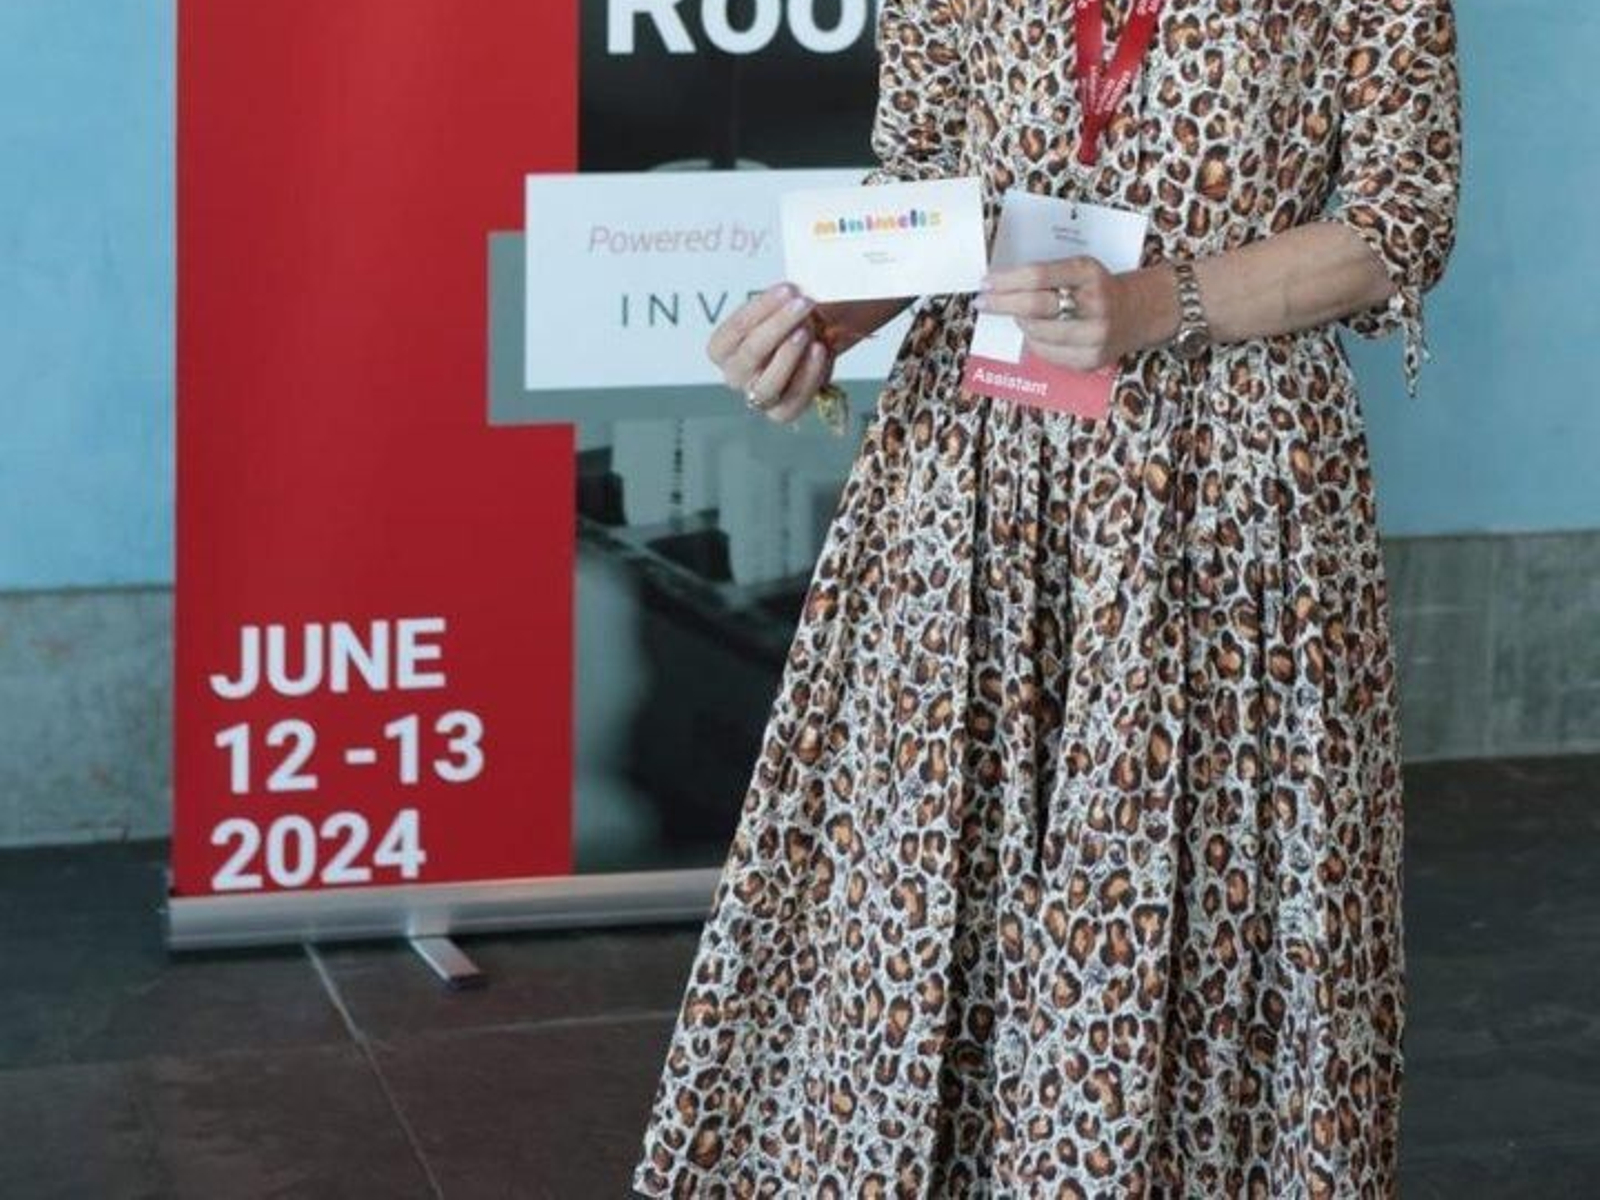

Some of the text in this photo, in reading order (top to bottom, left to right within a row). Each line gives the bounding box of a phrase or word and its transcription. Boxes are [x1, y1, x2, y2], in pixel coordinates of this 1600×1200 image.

[588, 220, 724, 255] Powered
[620, 289, 772, 328] INV
[972, 366, 1050, 397] Assistant
[209, 616, 447, 700] JUNE
[214, 717, 319, 795] 12
[210, 807, 428, 892] 2024
